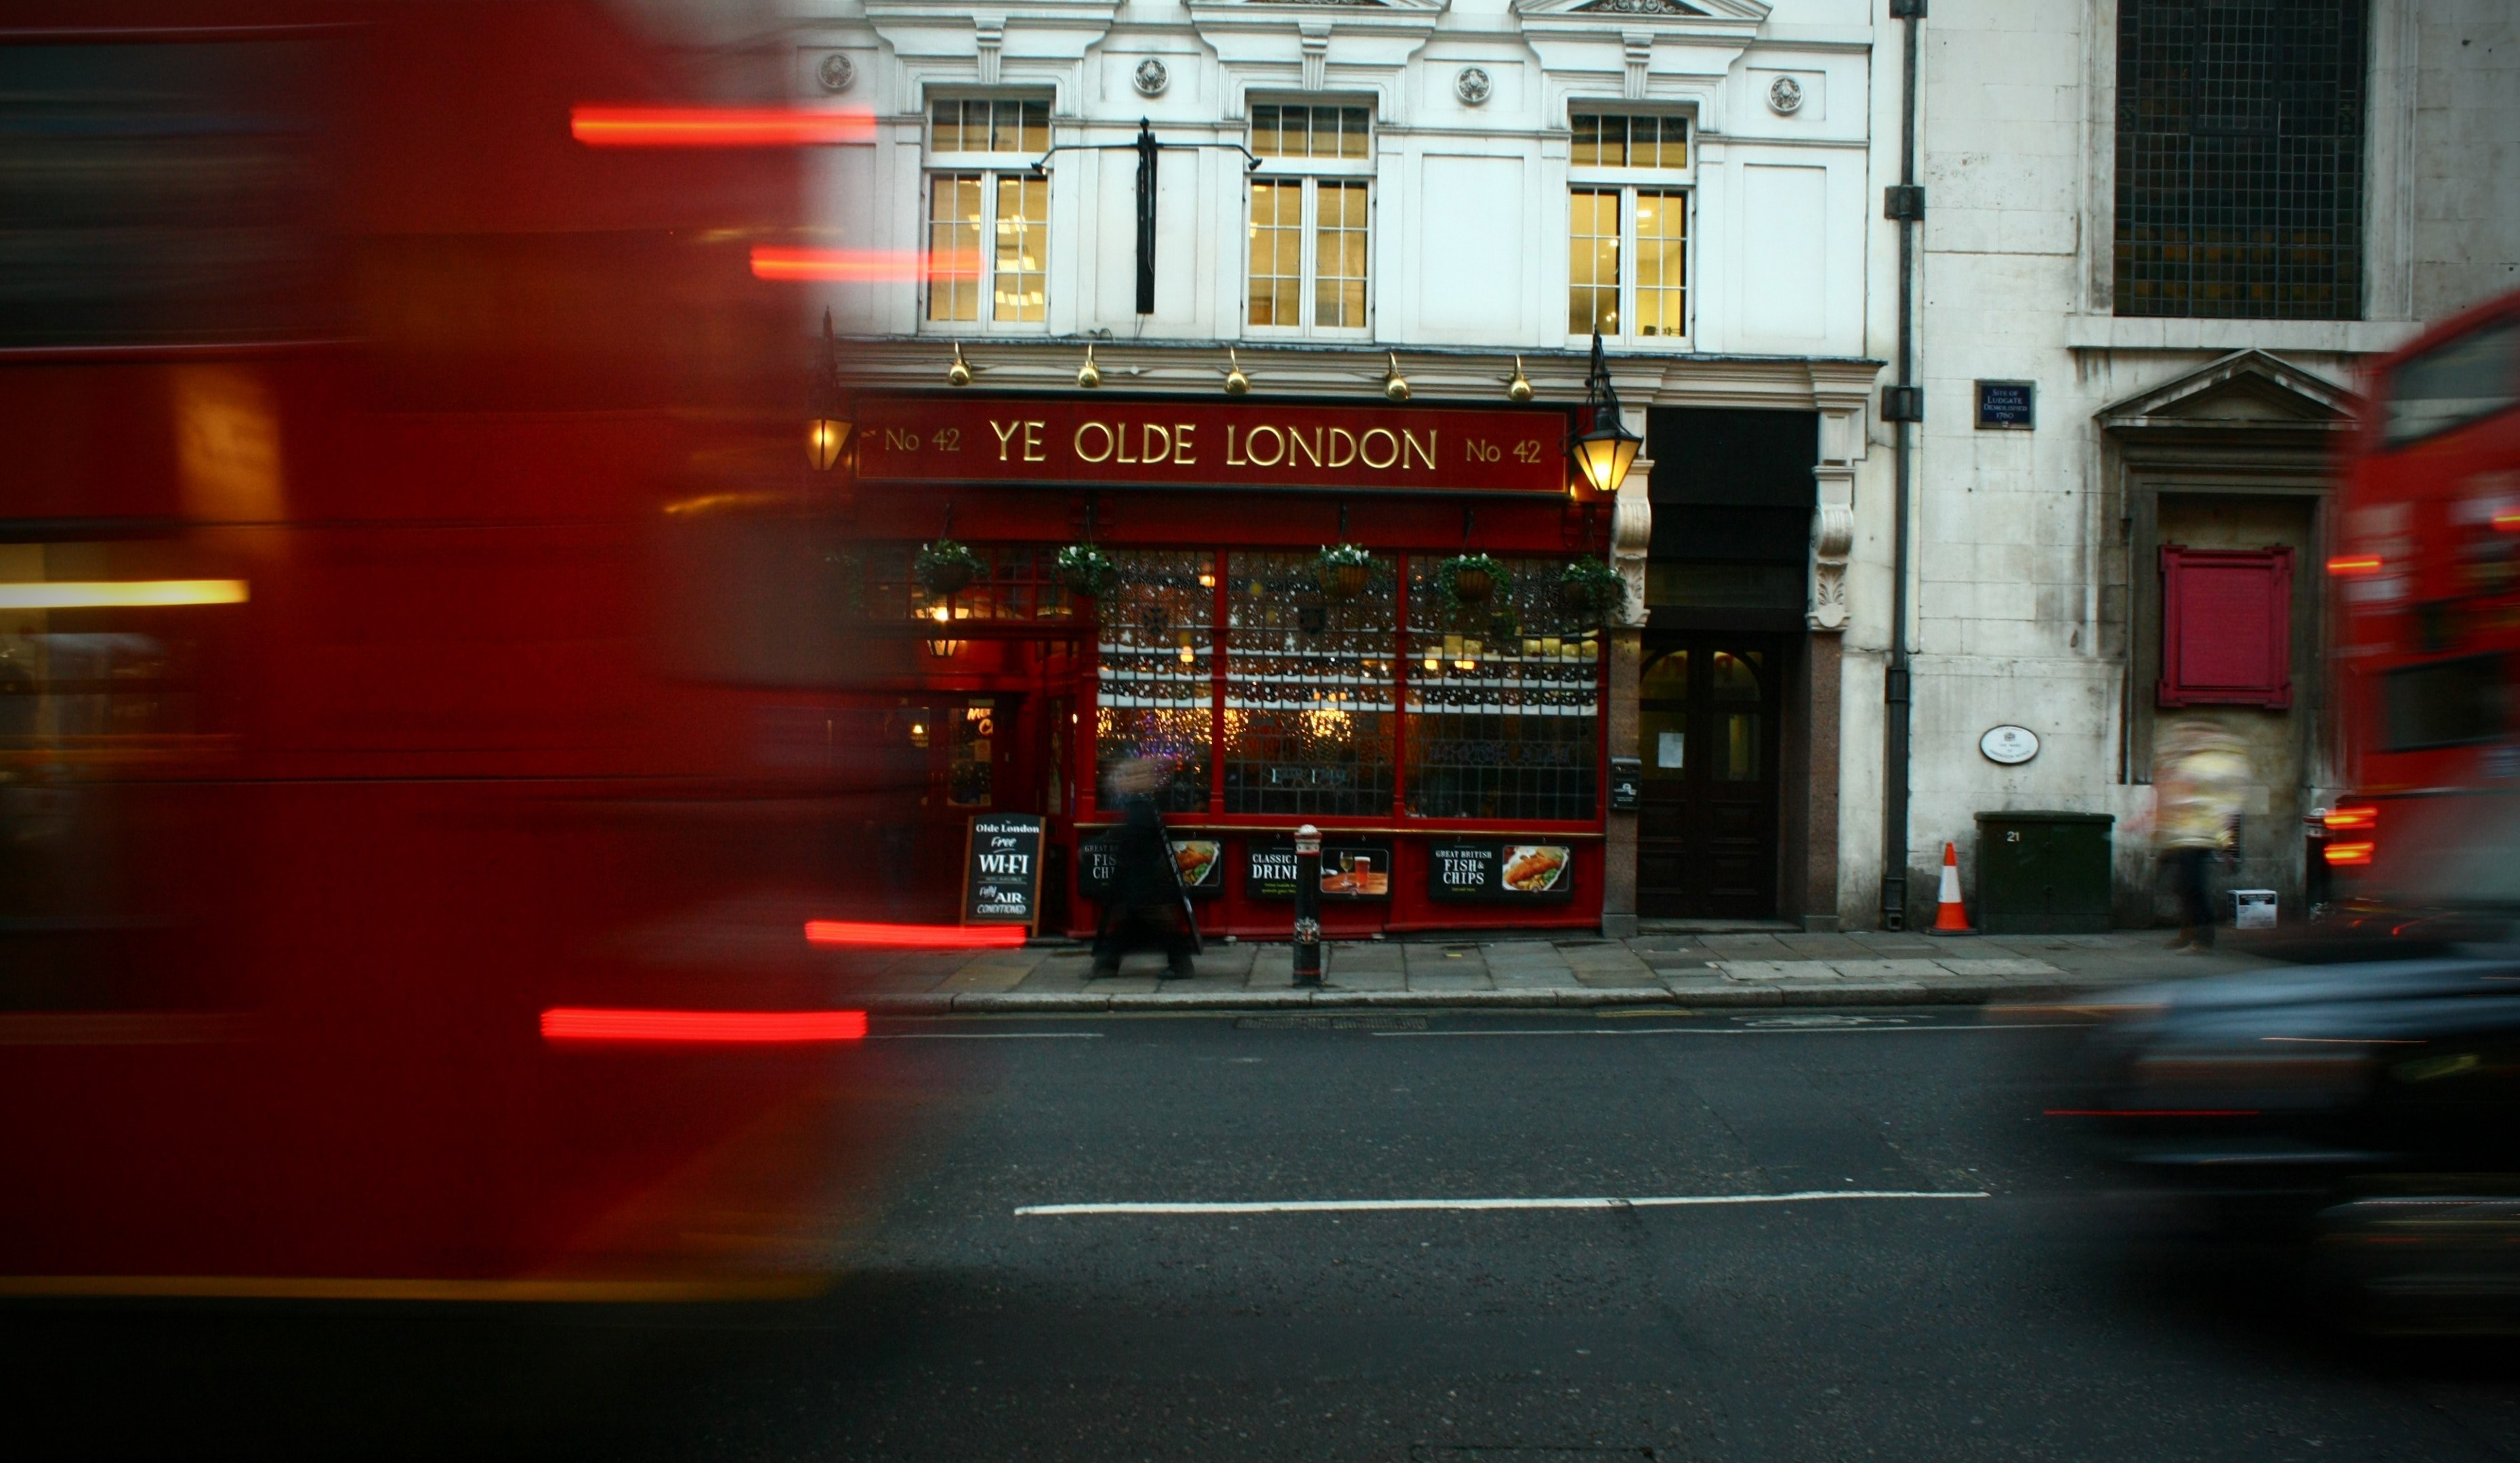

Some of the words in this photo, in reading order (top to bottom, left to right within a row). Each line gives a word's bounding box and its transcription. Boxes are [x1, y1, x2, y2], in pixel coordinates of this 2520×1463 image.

[1988, 396, 2023, 404] LUDGATE
[885, 427, 919, 451] No
[931, 427, 961, 452] 42
[989, 419, 1047, 462] YE
[1074, 421, 1197, 465] OLDE
[1225, 424, 1437, 470] LONDON
[1465, 438, 1501, 463] No
[1513, 440, 1542, 464] 42
[975, 824, 1000, 833] Olde
[1001, 824, 1040, 834] London
[990, 836, 1017, 848] Free
[2006, 830, 2020, 843] 21
[1093, 853, 1117, 866] FIS
[1252, 853, 1292, 864] CLASSIC
[1435, 849, 1460, 858] GREAT
[1461, 850, 1492, 860] BRITISH
[979, 853, 1030, 874] WI-FI
[1442, 872, 1485, 885] CHIPS
